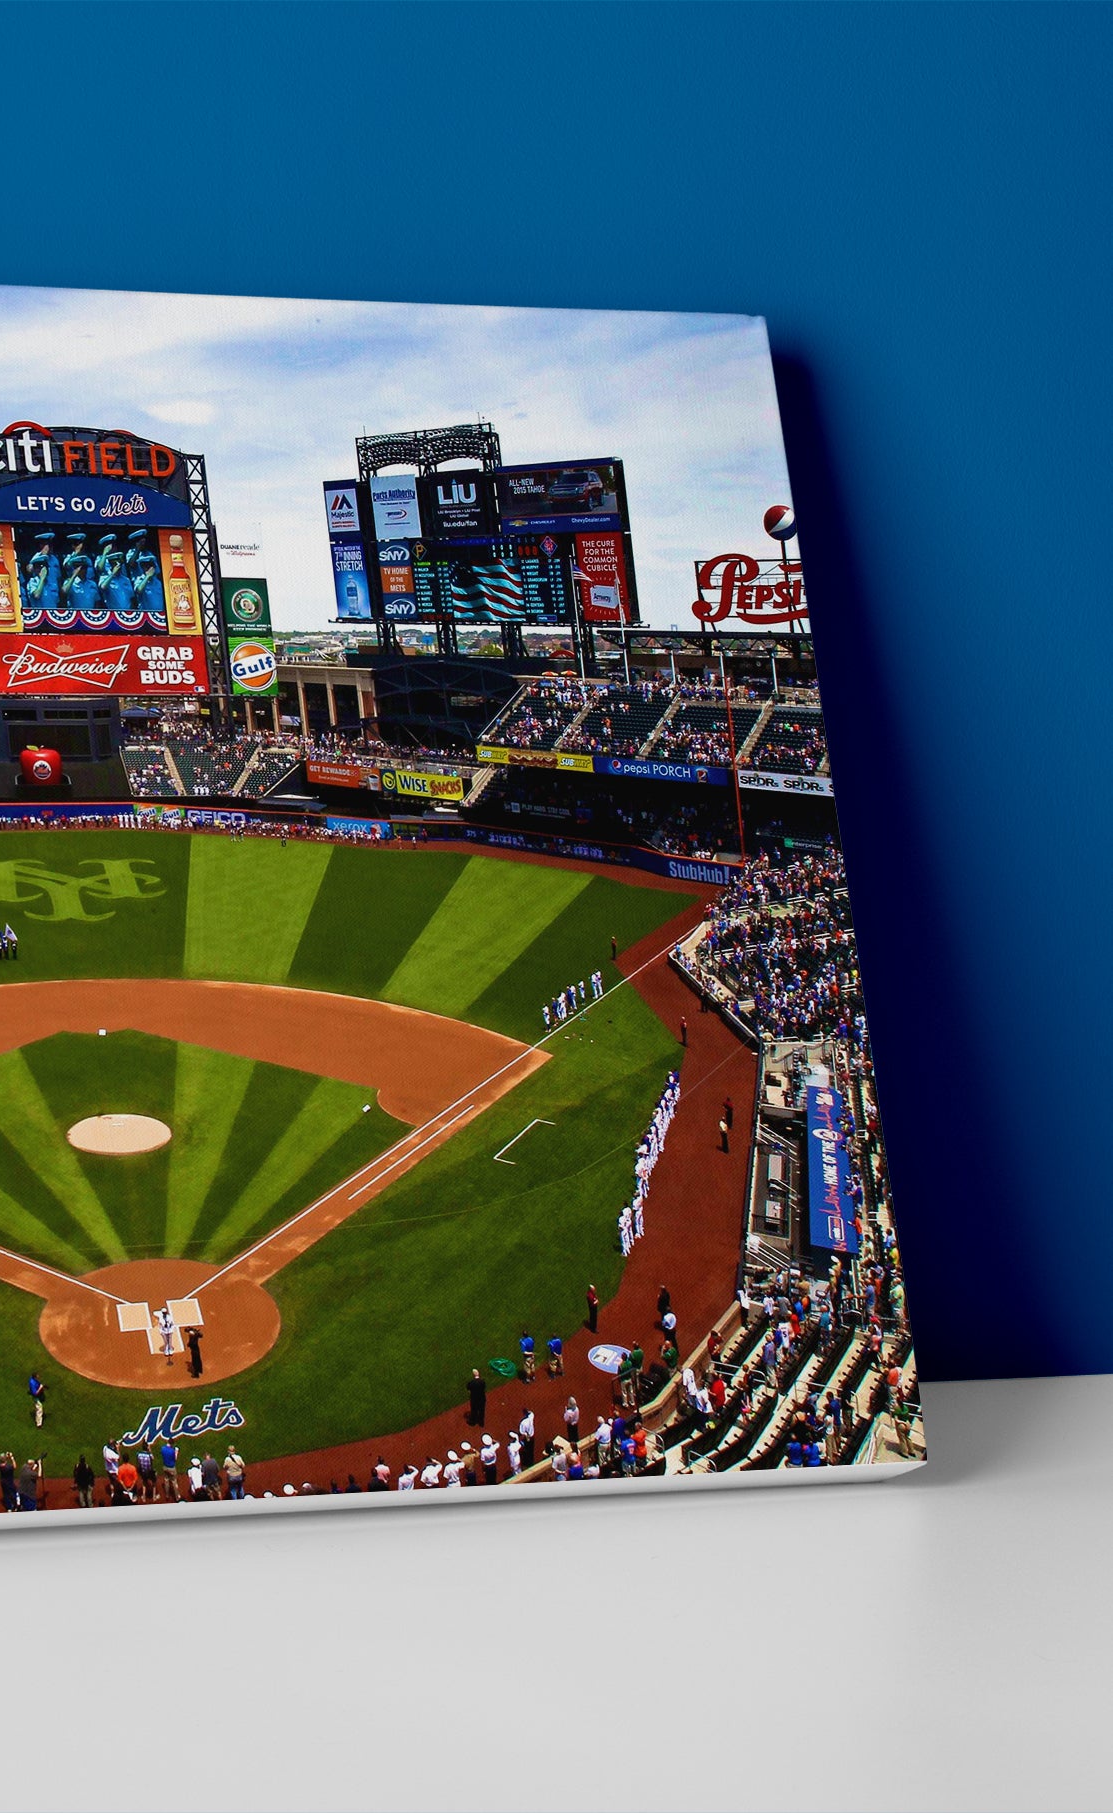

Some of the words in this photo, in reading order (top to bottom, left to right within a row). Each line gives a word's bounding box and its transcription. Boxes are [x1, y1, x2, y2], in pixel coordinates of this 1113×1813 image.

[63, 440, 175, 477] FIELD
[508, 478, 535, 487] ALL-NEW
[437, 480, 477, 505] LIU
[513, 486, 526, 494] 2015
[527, 485, 545, 494] TAHOE
[17, 496, 64, 511] LET'S
[71, 497, 95, 512] GO
[100, 493, 147, 517] Mets
[331, 511, 354, 520] Majestic
[596, 540, 615, 548] CURE
[379, 551, 403, 562] SNY
[585, 548, 599, 556] FOR
[600, 547, 615, 555] THE
[583, 556, 618, 564] COMMON
[335, 561, 363, 572] STRETCH
[391, 567, 408, 575] HOME
[586, 564, 616, 572] CUBICLE
[390, 584, 406, 592] METS
[385, 604, 409, 615] SNY
[137, 646, 194, 661] GRAB
[2, 654, 128, 676] Budweiser
[148, 660, 186, 670] SOME
[232, 656, 273, 677] Gulf
[140, 670, 196, 685] BUDS
[479, 750, 507, 760] SUBWAY
[560, 757, 591, 769] SUBWAY
[624, 763, 651, 776] pepsi
[653, 764, 691, 778] PORCH
[399, 775, 429, 793] WISE
[429, 777, 462, 797] SNACKS
[187, 810, 246, 824] GEICO
[333, 821, 367, 832] xerox
[669, 861, 730, 886] StubHub!
[822, 1139, 837, 1152] THE
[823, 1151, 837, 1163] OF
[823, 1163, 838, 1186] HOME
[122, 1398, 245, 1447] Mets
